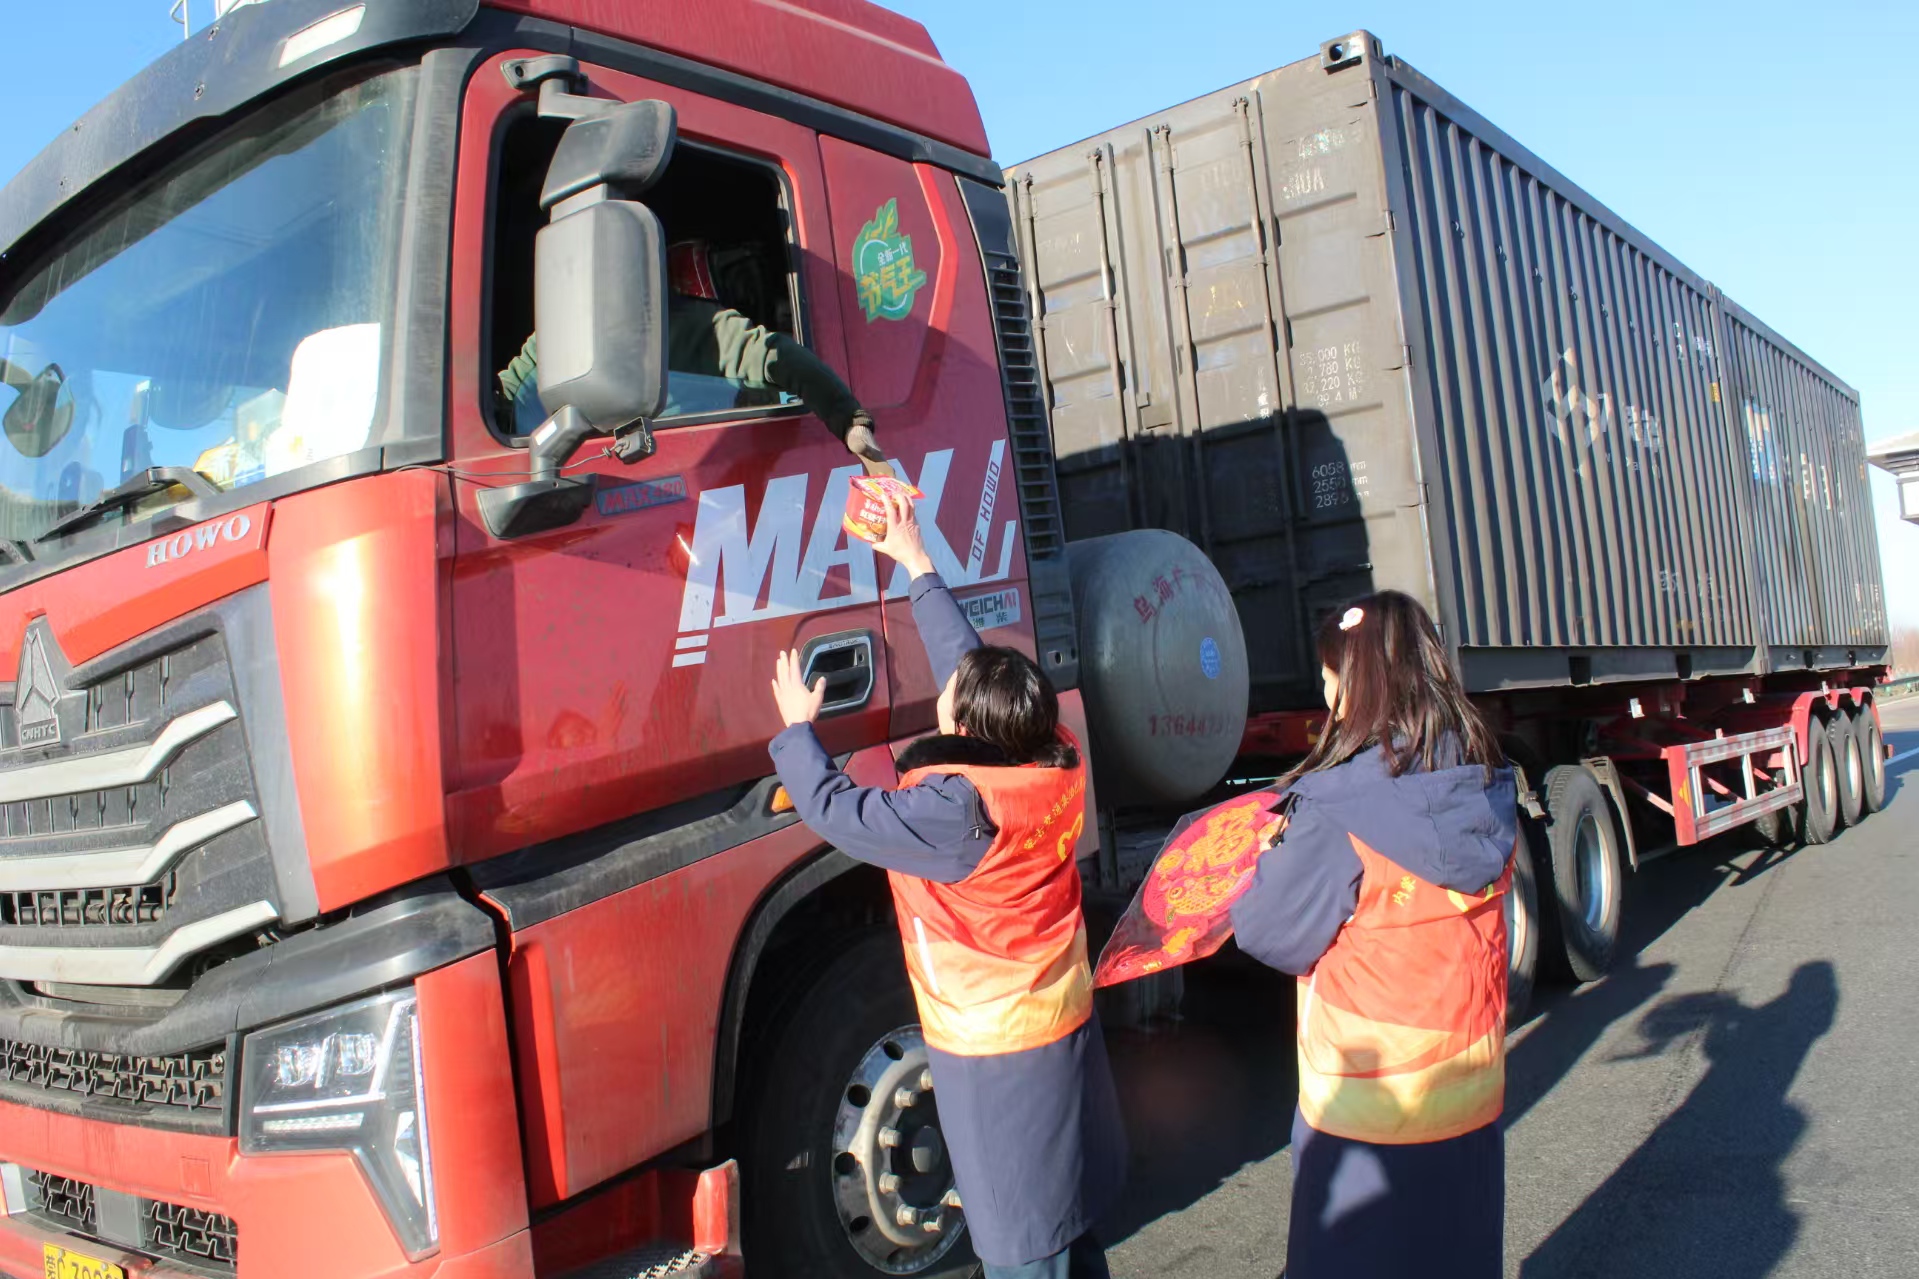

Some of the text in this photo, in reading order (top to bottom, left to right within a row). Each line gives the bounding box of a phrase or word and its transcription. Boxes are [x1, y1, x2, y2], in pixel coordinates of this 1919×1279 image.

[1311, 461, 1345, 479] 6058
[971, 460, 1000, 562] OF HOWO
[145, 514, 251, 569] HOWO
[22, 723, 57, 741] CNHTC
